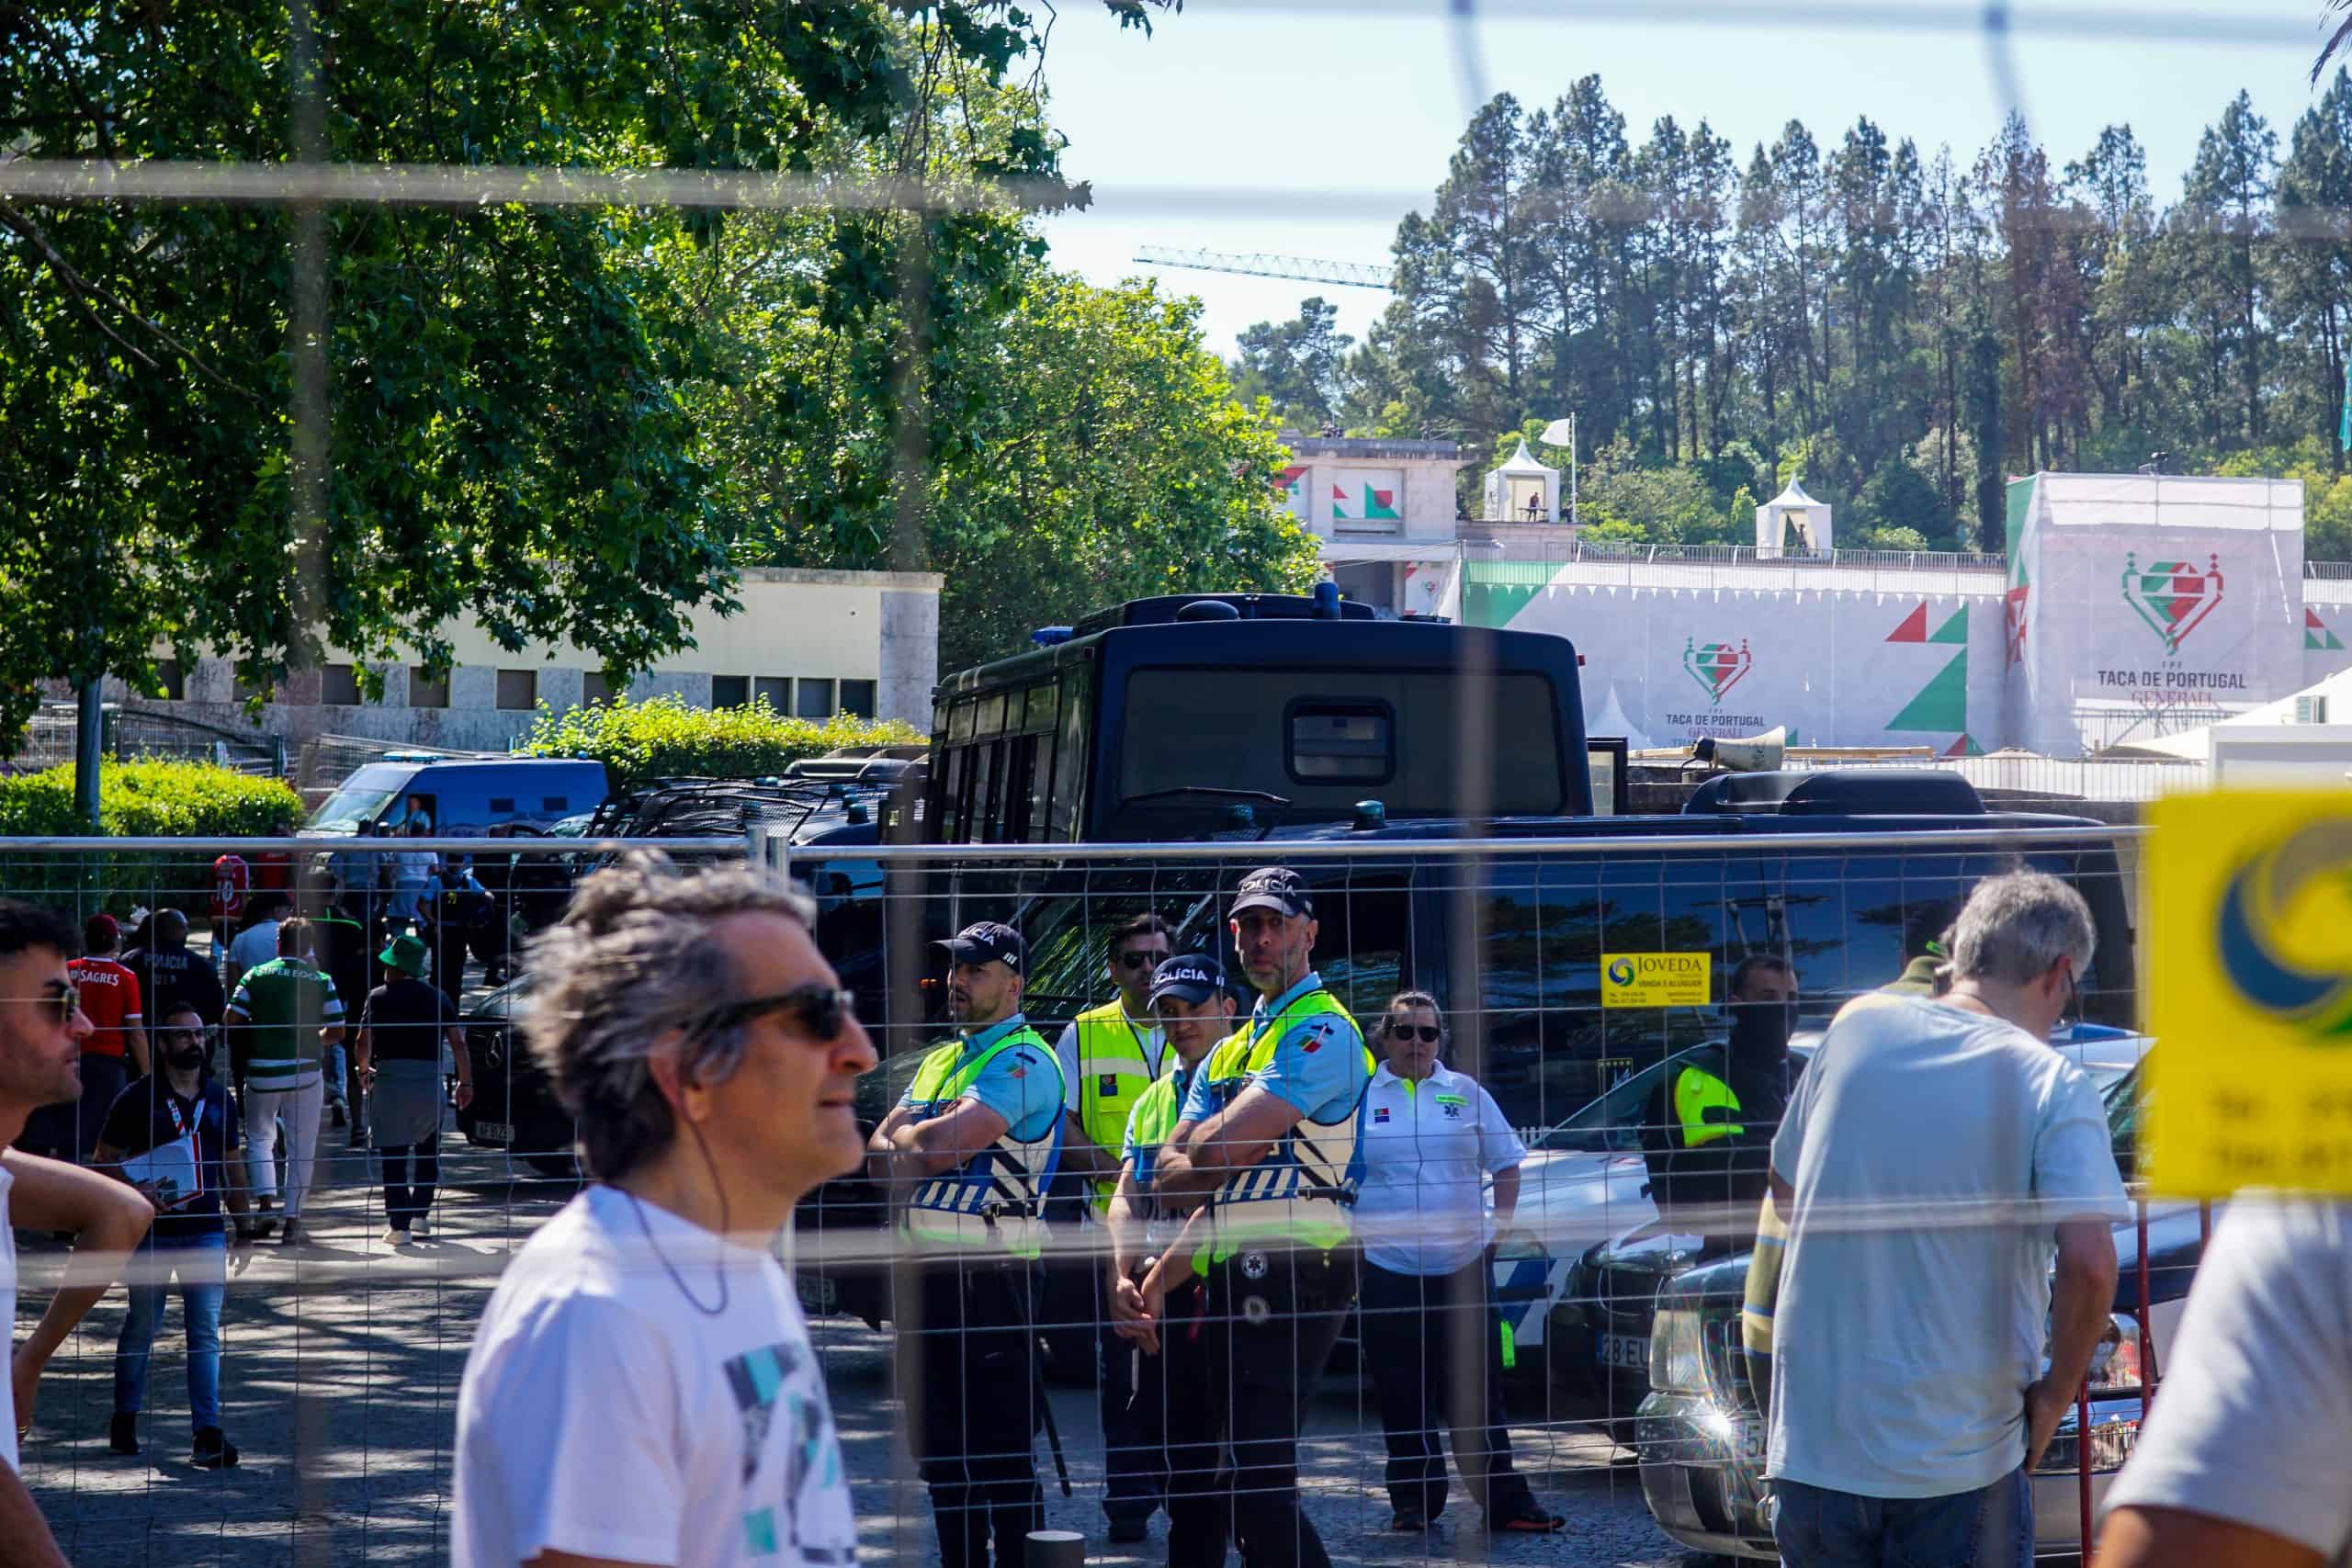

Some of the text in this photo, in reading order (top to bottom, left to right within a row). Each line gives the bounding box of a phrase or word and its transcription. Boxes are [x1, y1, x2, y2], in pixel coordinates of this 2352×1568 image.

[2142, 671, 2162, 687] DE
[2166, 671, 2246, 689] PORTUGAL
[1695, 715, 1710, 726] DE
[1712, 715, 1765, 728] PORTUGAL
[1638, 956, 1702, 974] JOVEDA
[80, 969, 119, 987] SAGRES
